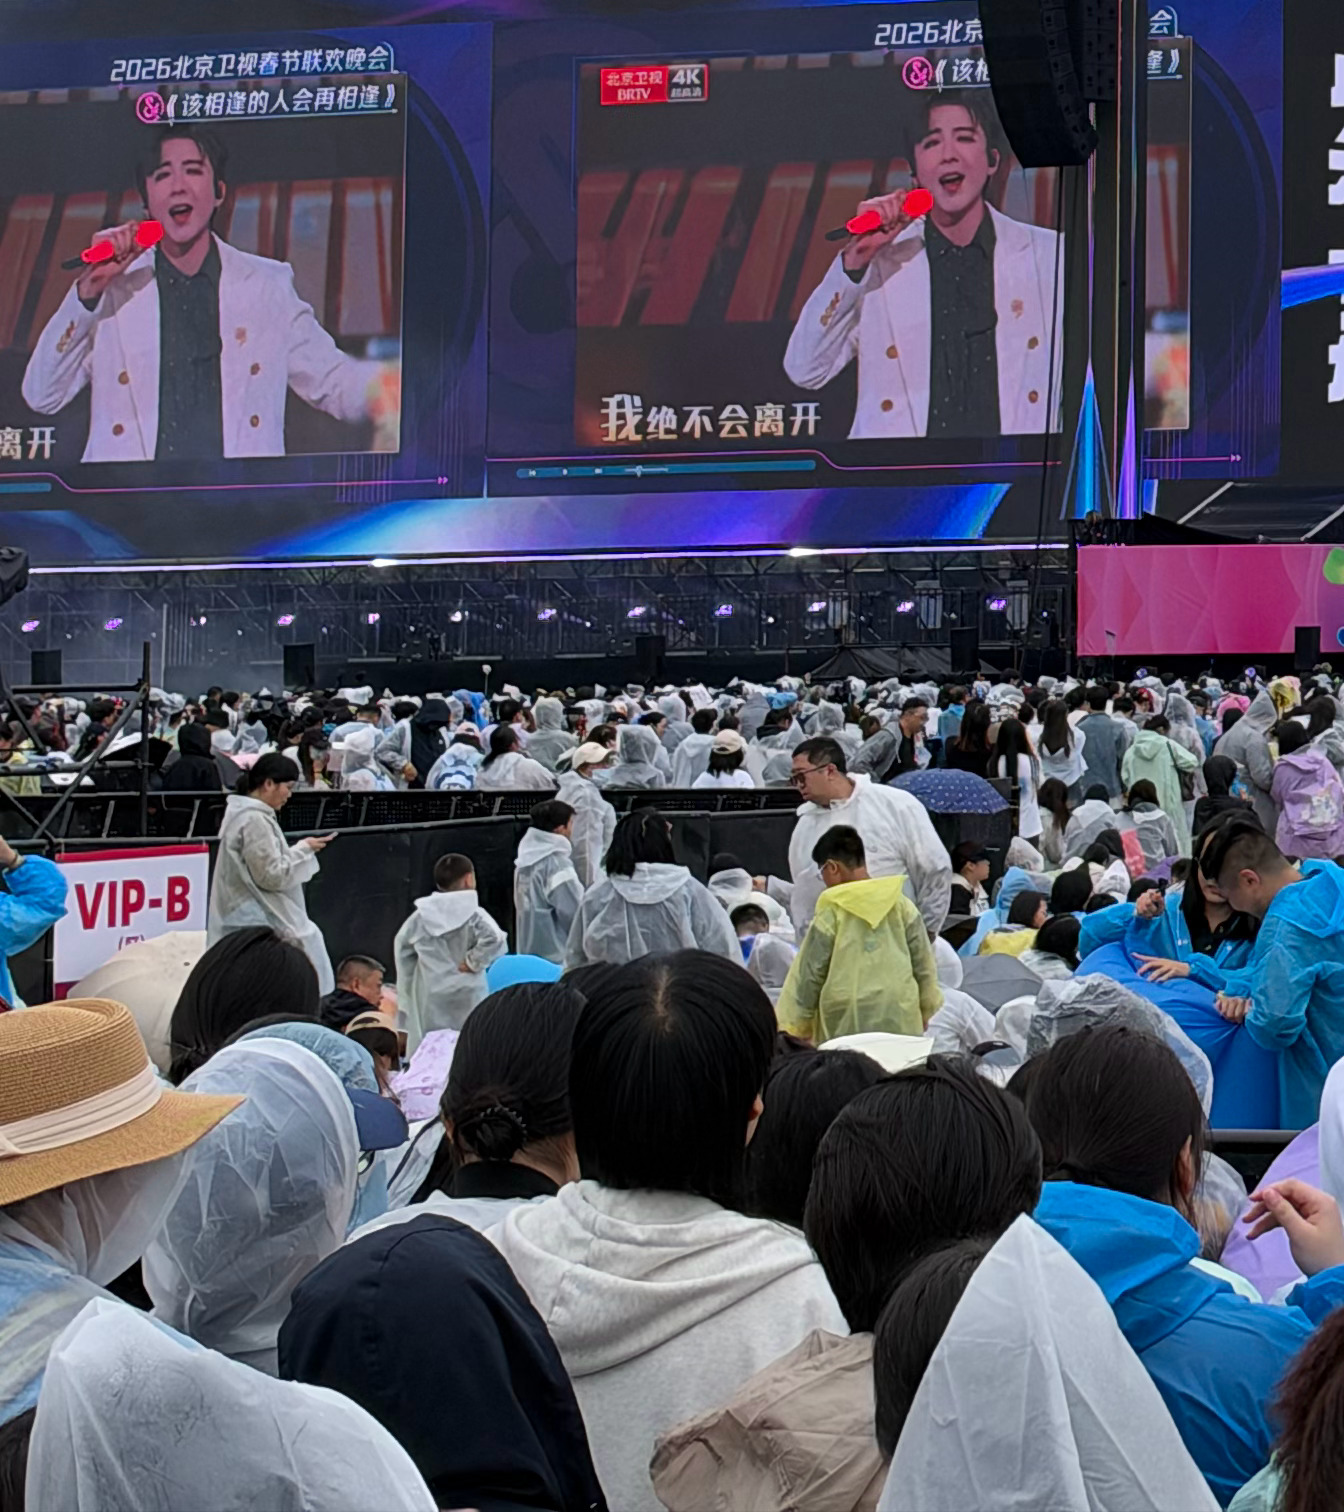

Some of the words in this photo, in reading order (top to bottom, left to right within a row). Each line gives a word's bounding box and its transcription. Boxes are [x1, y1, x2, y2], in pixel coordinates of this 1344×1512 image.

[110, 45, 390, 82] 2026北京卫视春节联欢晚会
[606, 71, 663, 87] 北京卫视
[671, 69, 701, 85] 4K
[166, 83, 395, 118] 《该相逢的人会再相逢》
[617, 88, 651, 101] BRTV
[600, 393, 822, 442] 我绝不会离开
[74, 875, 191, 931] VIP-B
